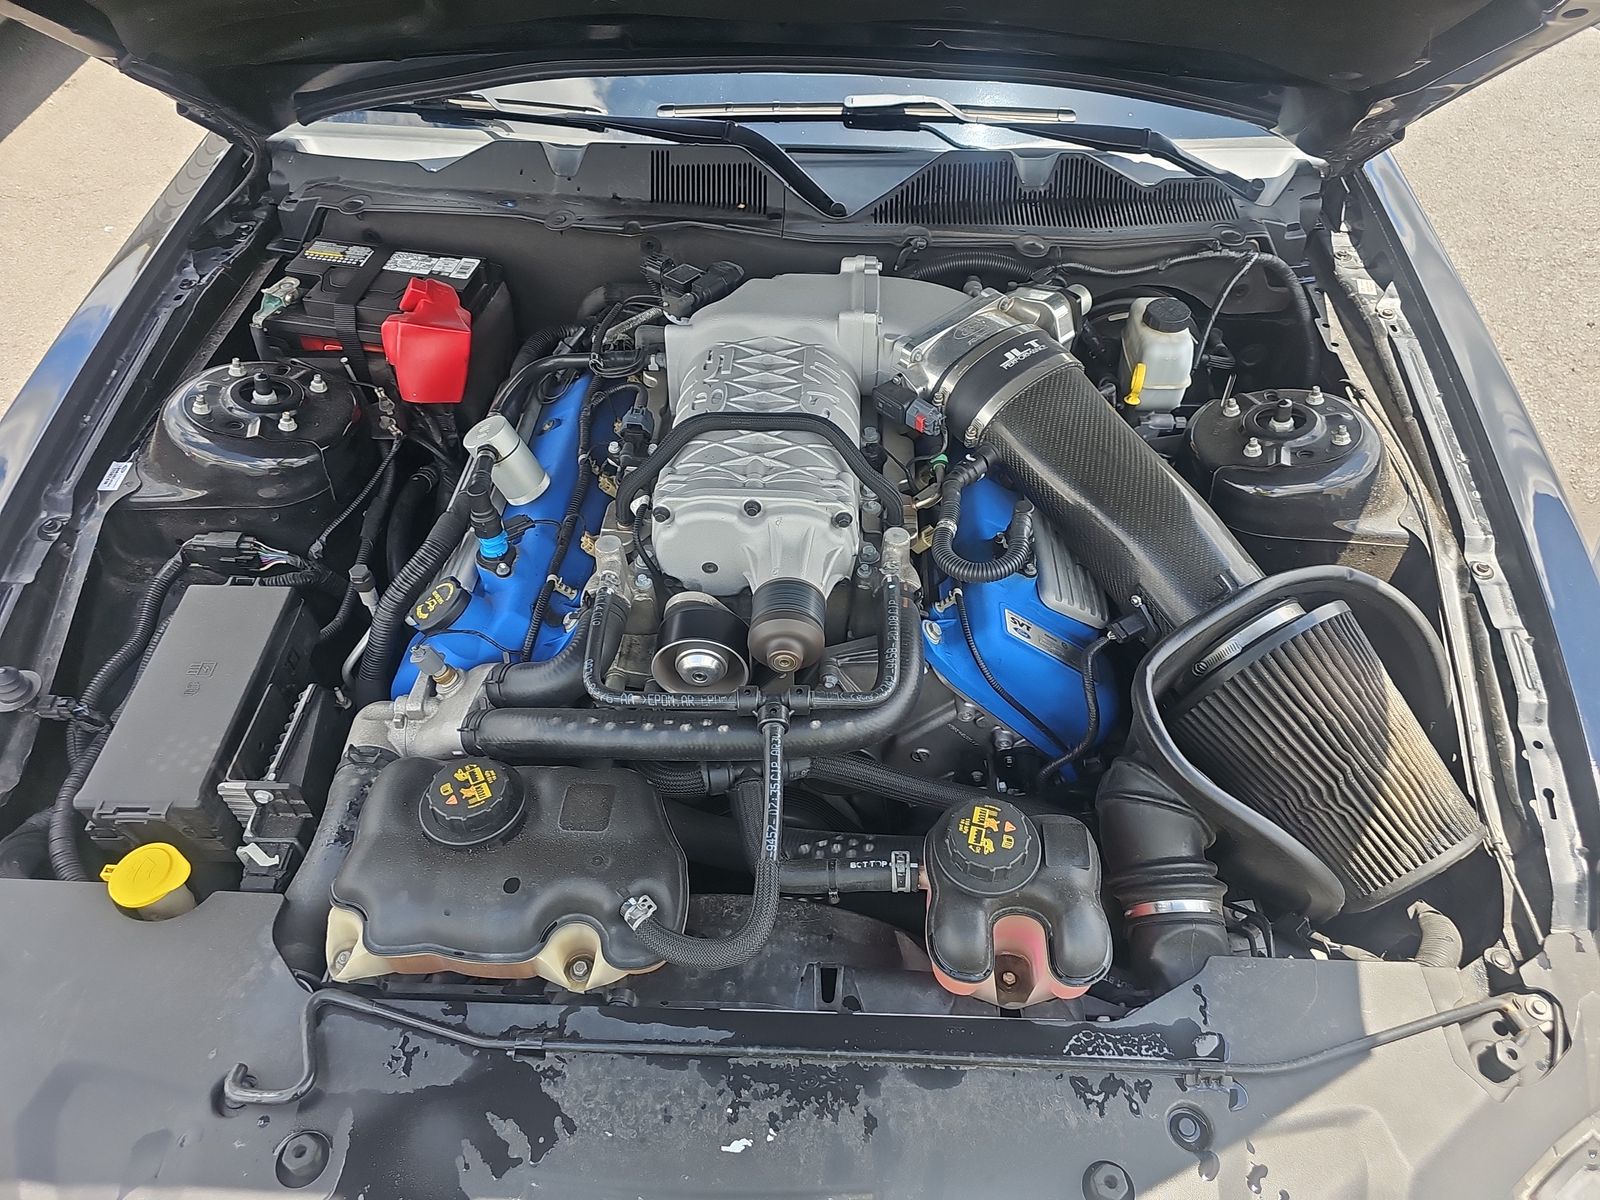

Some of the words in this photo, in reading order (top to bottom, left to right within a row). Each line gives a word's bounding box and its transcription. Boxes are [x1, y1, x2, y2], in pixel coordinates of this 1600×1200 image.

[1000, 345, 1048, 370] PERFORMANCE
[1003, 339, 1039, 361] JLT
[1010, 616, 1032, 632] SVT
